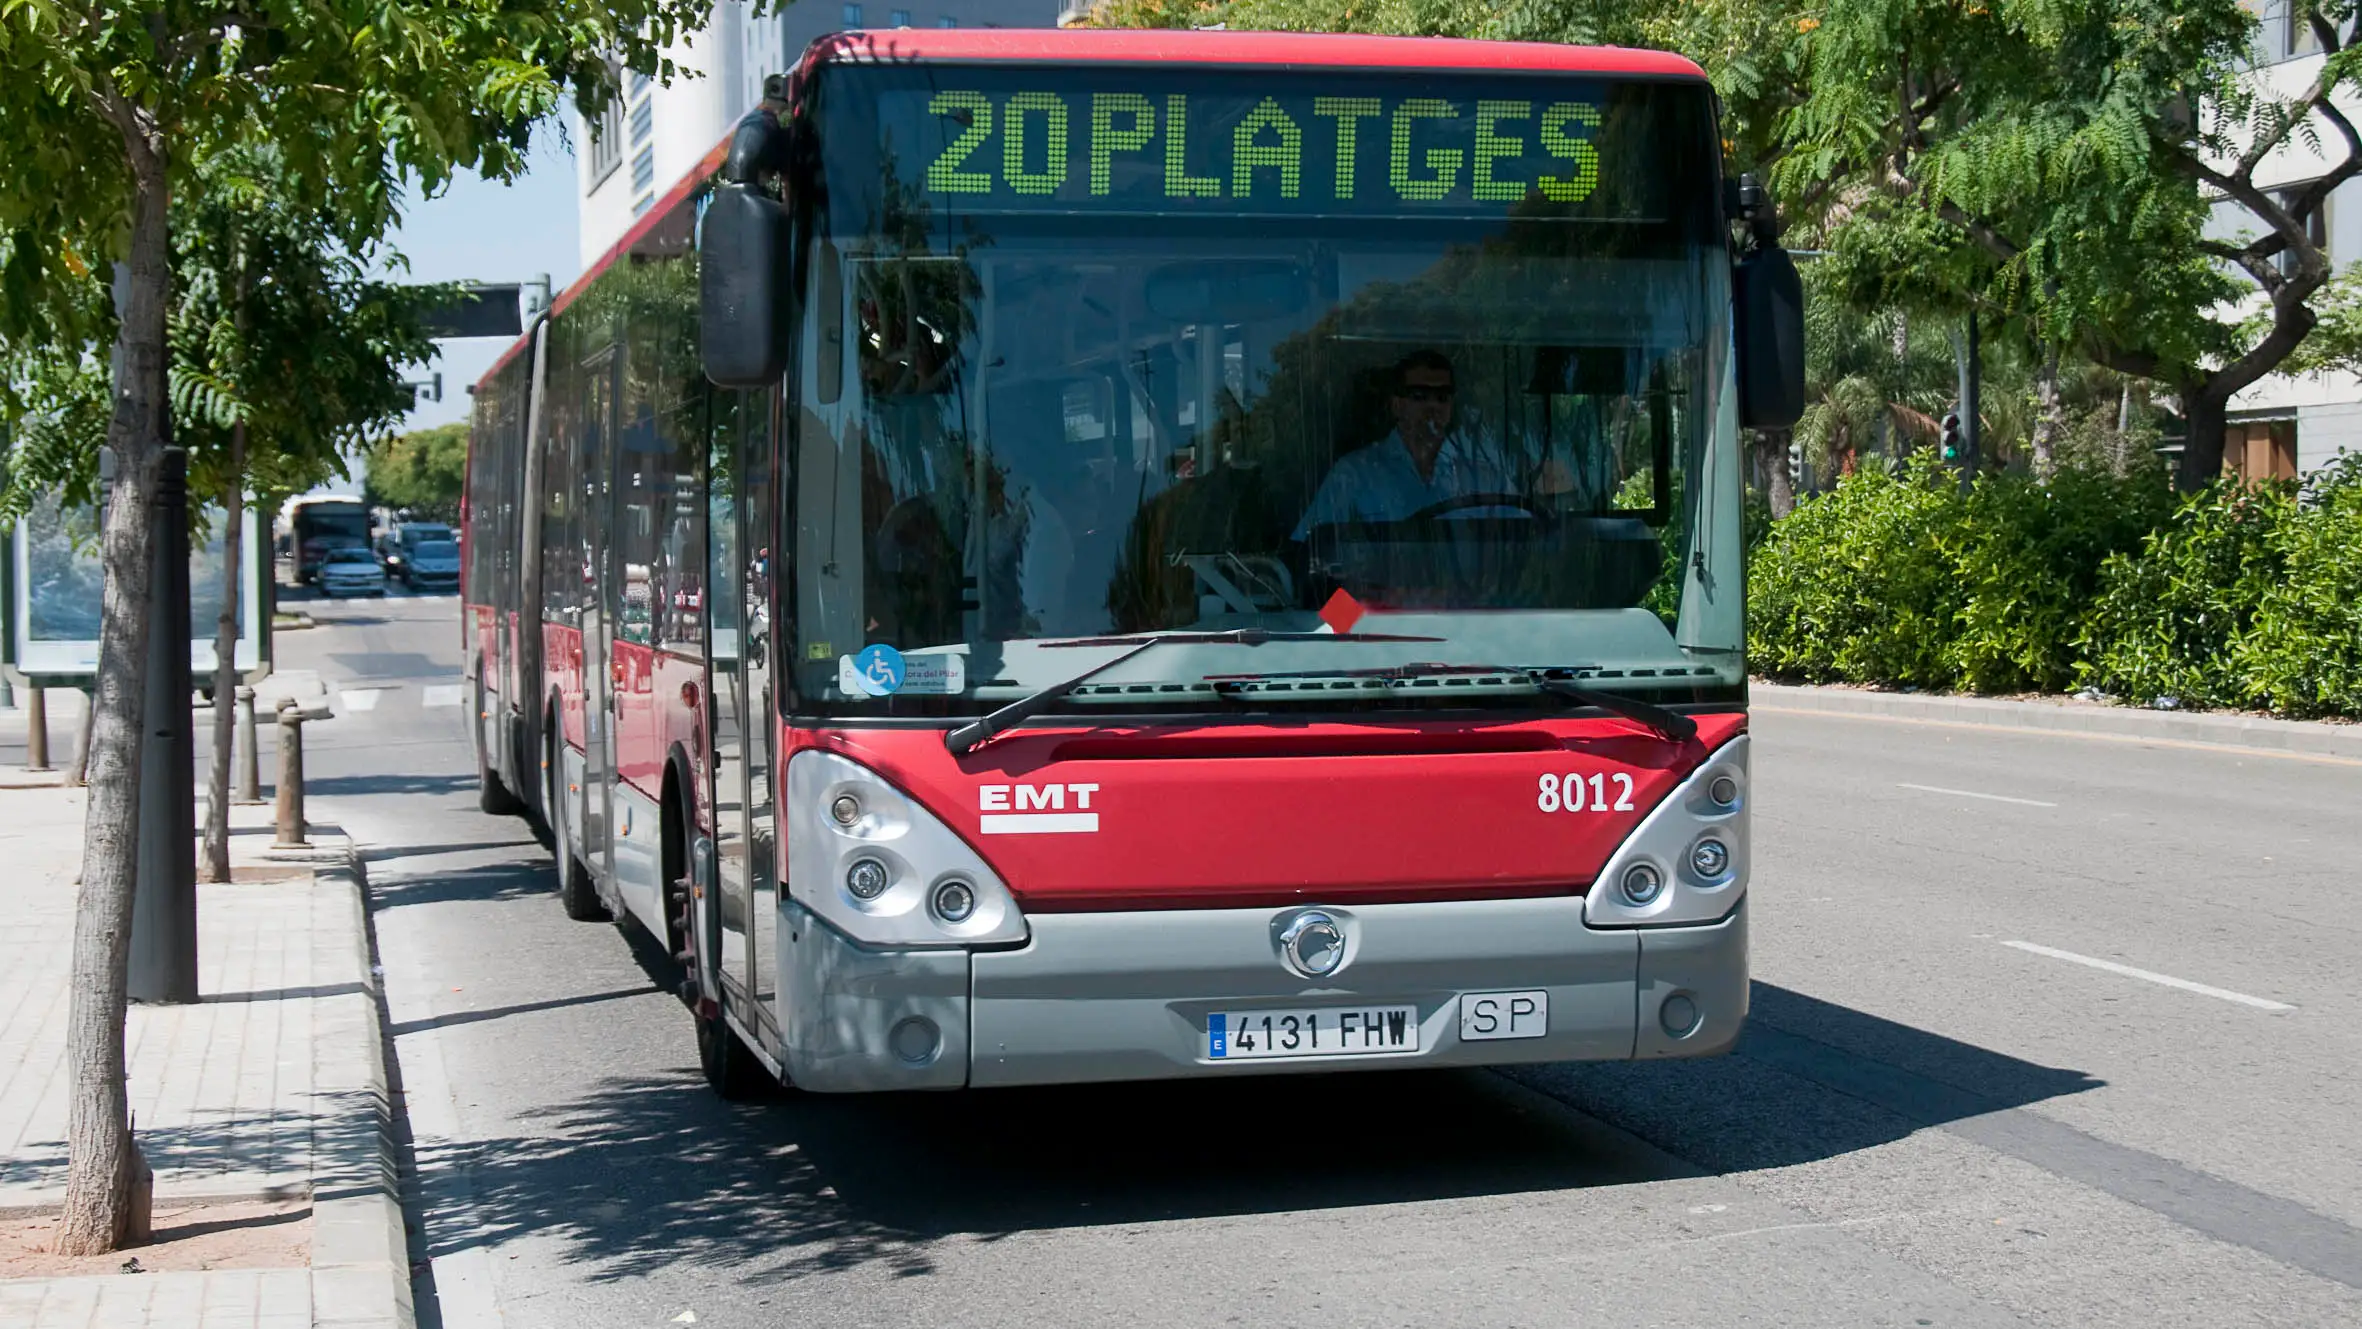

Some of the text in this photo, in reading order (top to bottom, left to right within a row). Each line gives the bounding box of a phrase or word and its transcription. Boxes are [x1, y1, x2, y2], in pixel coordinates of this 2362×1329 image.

[927, 90, 1602, 202] 20 PLATGES
[980, 783, 1099, 810] EMT
[1537, 772, 1634, 813] 8012
[1213, 1010, 1406, 1052] E 4131 FHW
[1473, 998, 1535, 1033] SP
